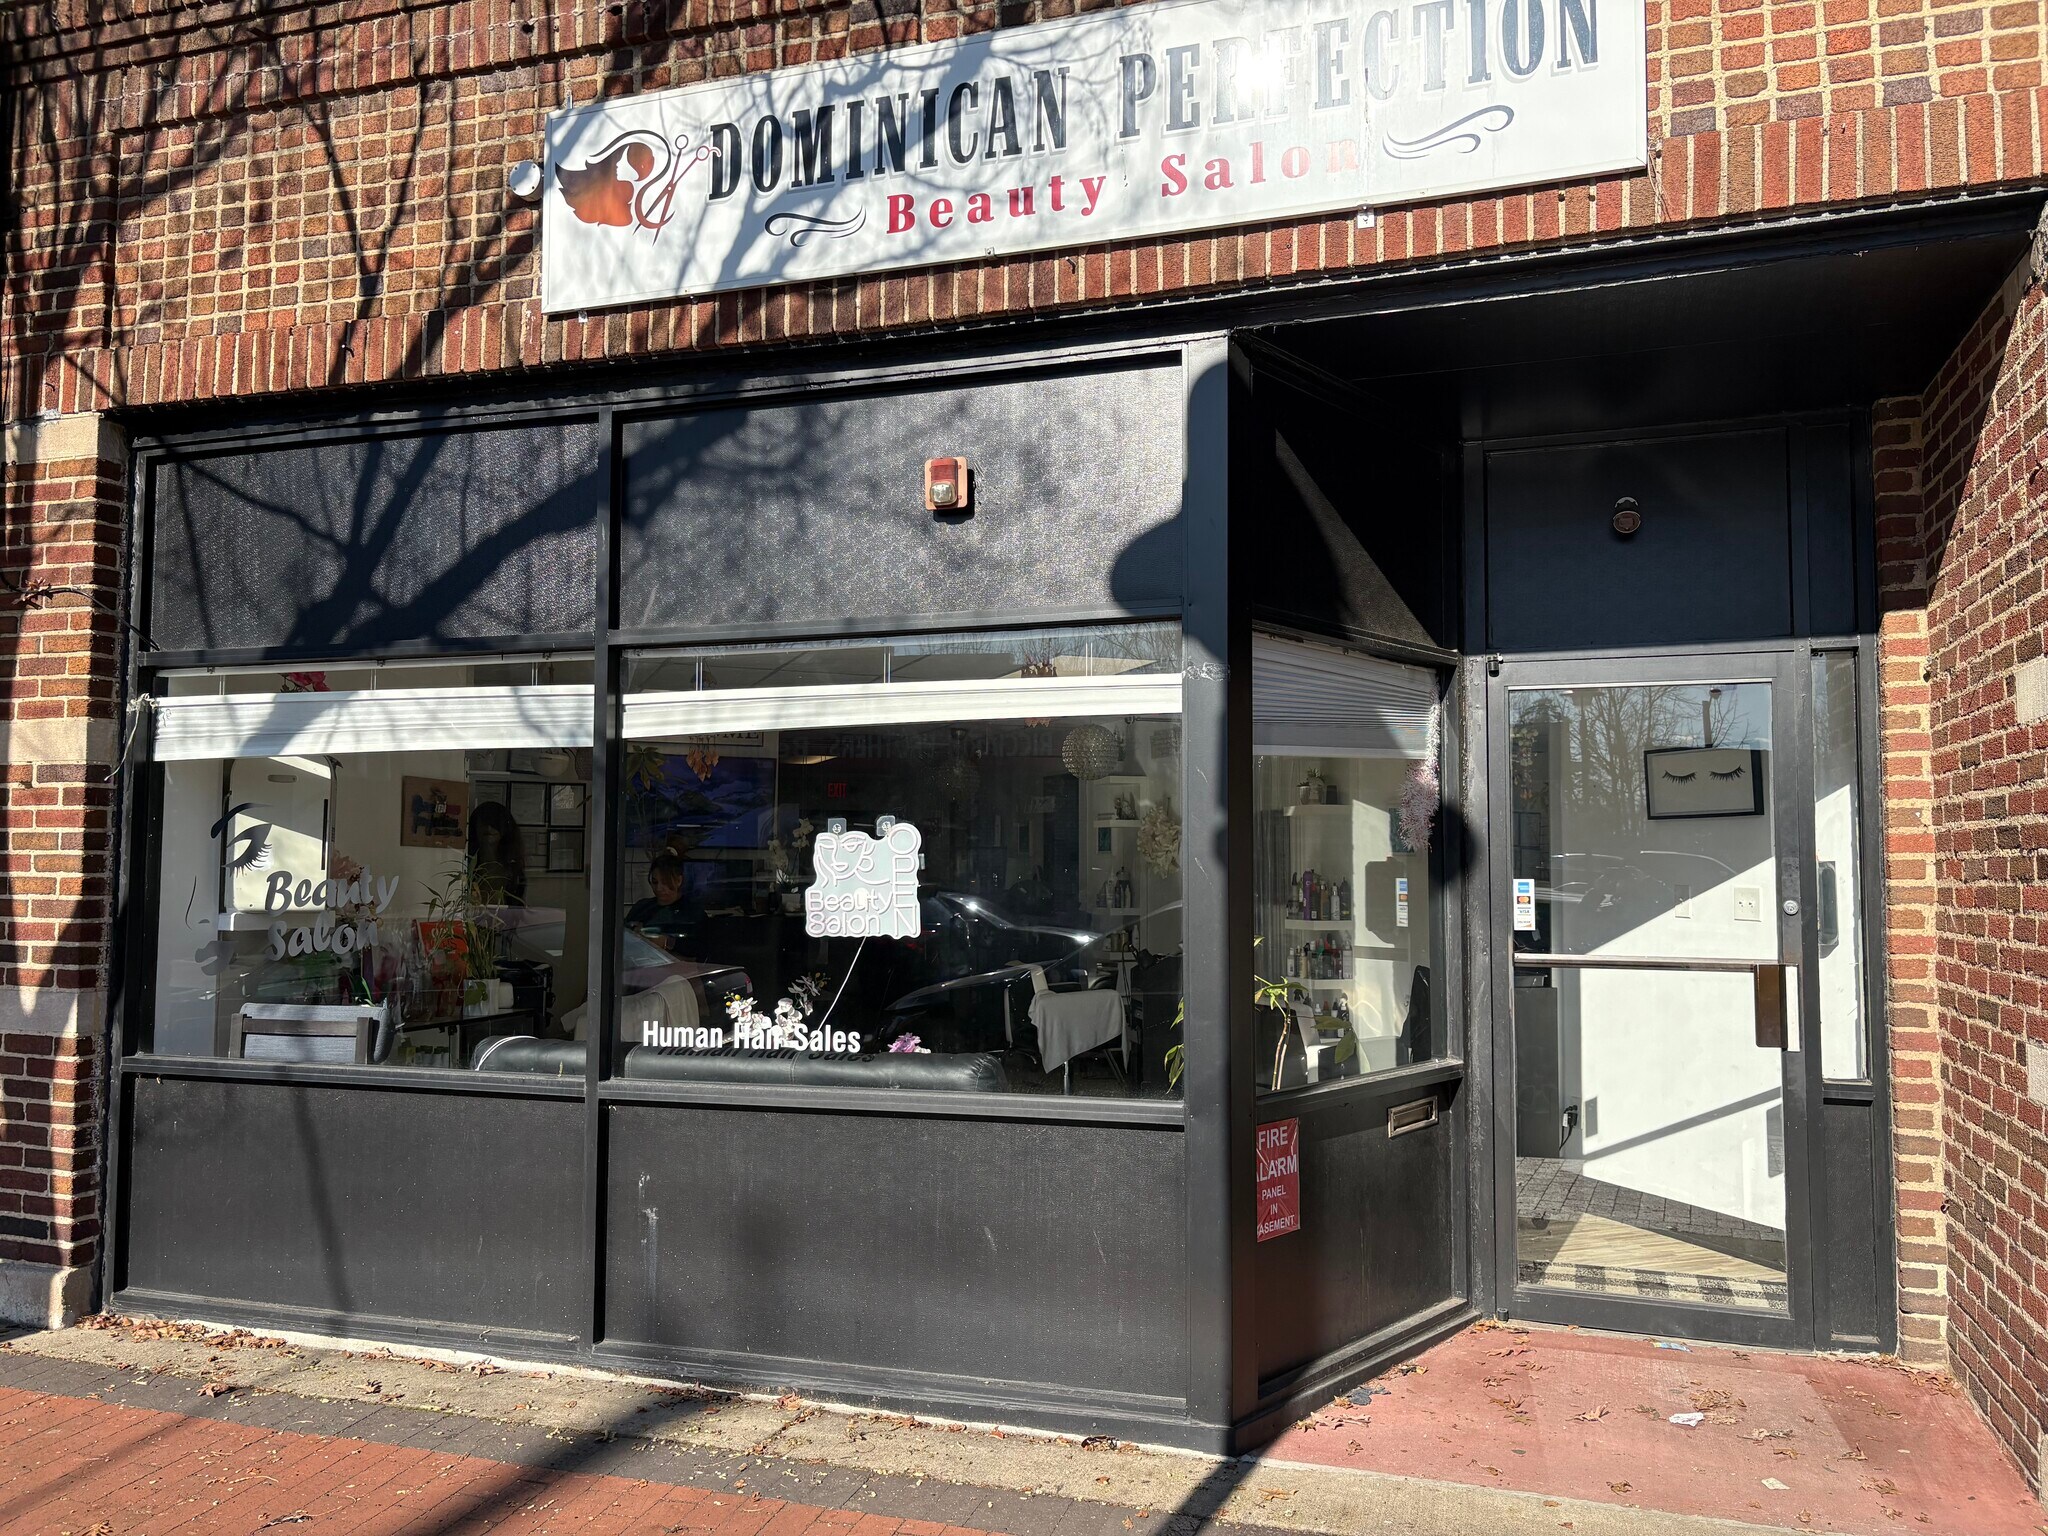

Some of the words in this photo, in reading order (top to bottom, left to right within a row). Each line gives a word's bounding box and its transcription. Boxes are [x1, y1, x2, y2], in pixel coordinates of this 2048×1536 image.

[708, 66, 1070, 201] DOMINICAN
[886, 175, 1106, 235] Beauty
[1161, 138, 1360, 198] Salon
[828, 783, 848, 800] EXIT
[264, 864, 400, 918] Beauty
[888, 823, 921, 938] OPEN
[807, 888, 894, 916] Beauty
[642, 1020, 724, 1048] Human
[793, 1023, 861, 1054] Sales
[1258, 1126, 1288, 1151] FIRE
[1262, 1185, 1286, 1200] PANEL
[1270, 1203, 1278, 1215] IN
